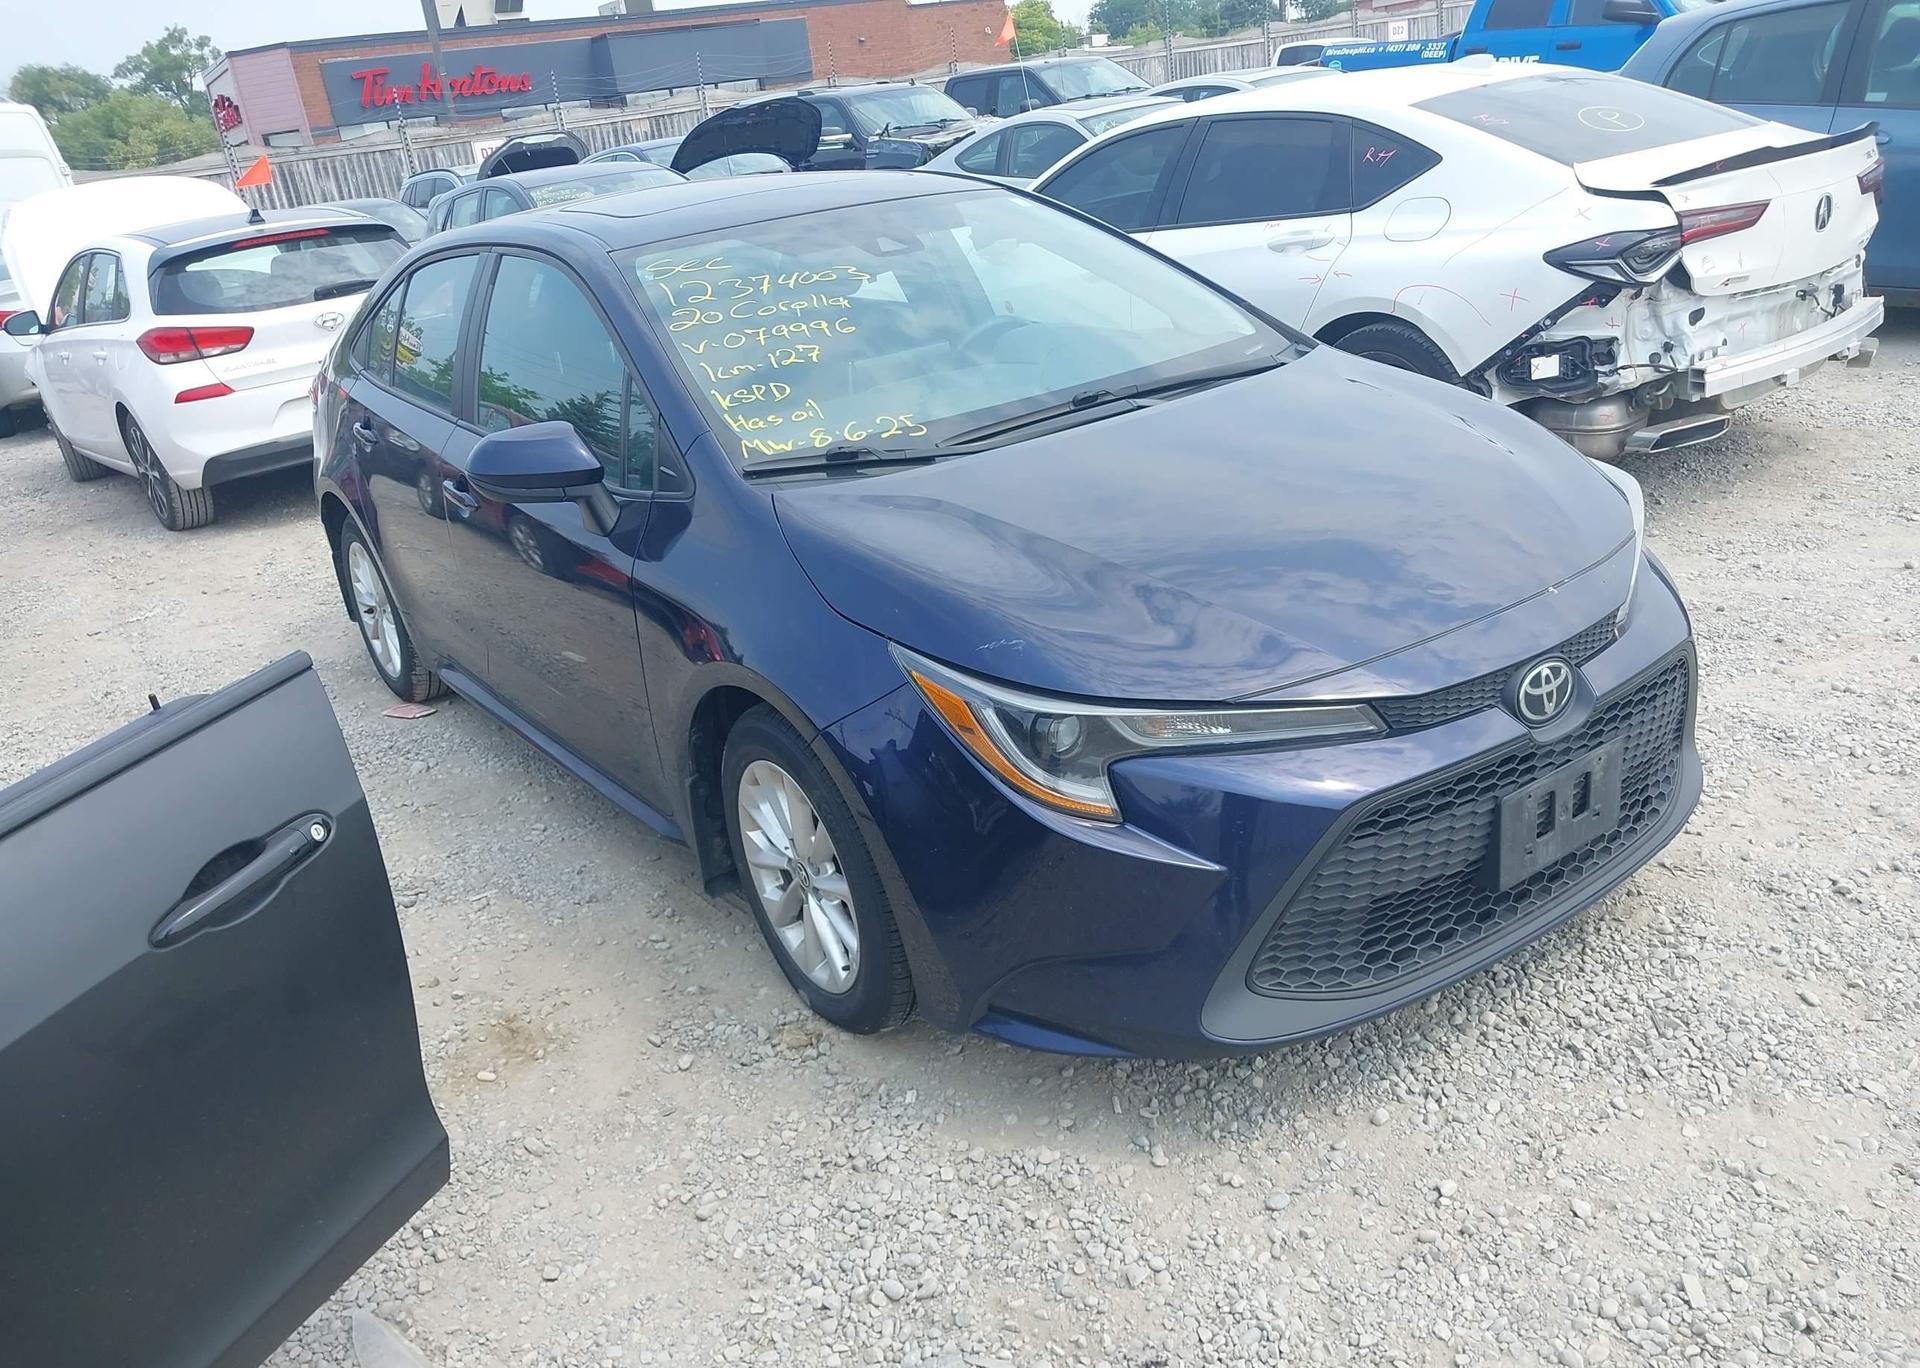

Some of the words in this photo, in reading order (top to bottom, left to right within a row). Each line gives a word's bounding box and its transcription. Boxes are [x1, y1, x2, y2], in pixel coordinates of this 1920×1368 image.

[1420, 49, 1447, 59] (DEEP)
[351, 67, 416, 109] Tim
[658, 265, 872, 307] 12374003
[669, 307, 724, 332] 20
[723, 413, 784, 432] Has
[791, 399, 825, 422] oil
